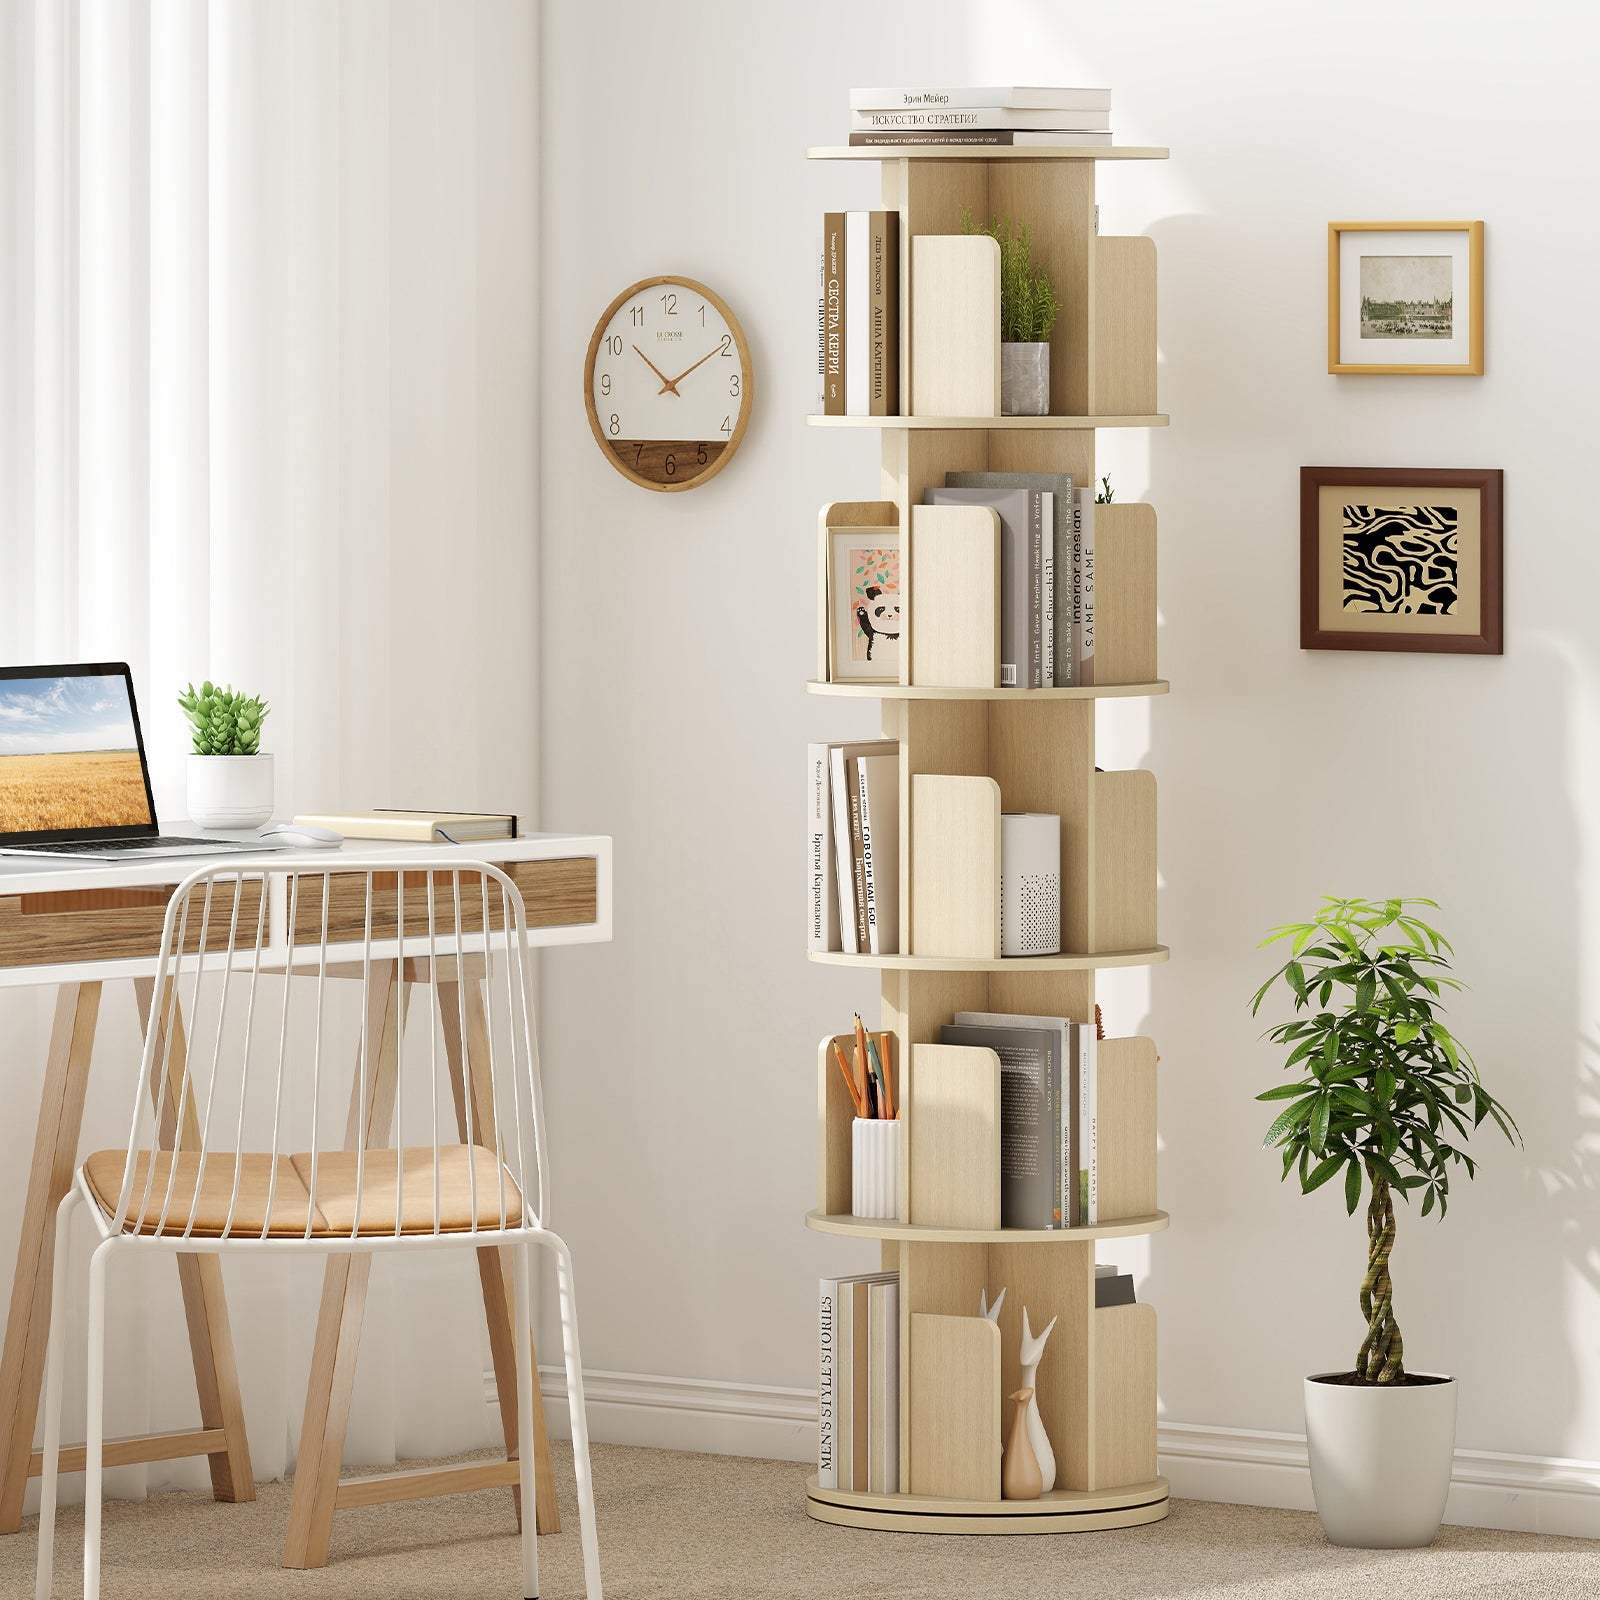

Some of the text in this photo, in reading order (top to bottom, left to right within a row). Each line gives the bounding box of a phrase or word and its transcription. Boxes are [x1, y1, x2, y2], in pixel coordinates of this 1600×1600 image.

[903, 93, 949, 105] Эрин Мейер
[872, 114, 978, 125] ИСКУССТВО СТРАТЕГИИ
[660, 294, 678, 315] 12
[828, 279, 839, 330] СЕСТРА
[630, 306, 644, 327] 11
[697, 305, 705, 327] 1
[605, 335, 623, 356] 10
[721, 334, 732, 357] 2
[828, 333, 839, 375] КЕРРИ
[601, 374, 611, 396] 9
[729, 375, 740, 397] 3
[609, 413, 620, 435] 8
[720, 415, 732, 437] 4
[633, 443, 644, 466] 7
[665, 454, 676, 476] 6
[697, 443, 708, 465] 5
[1066, 529, 1072, 540] in
[1085, 549, 1094, 647] SAME SAME
[1066, 606, 1072, 617] an
[812, 833, 823, 871] Братья
[855, 857, 864, 908] Бархатная
[863, 826, 876, 926] ГОВОРИ КАК БОГ
[812, 873, 823, 939] Карамазовы
[858, 908, 867, 942] смерть
[820, 1296, 832, 1471] MEN'S STYLE STORIES
